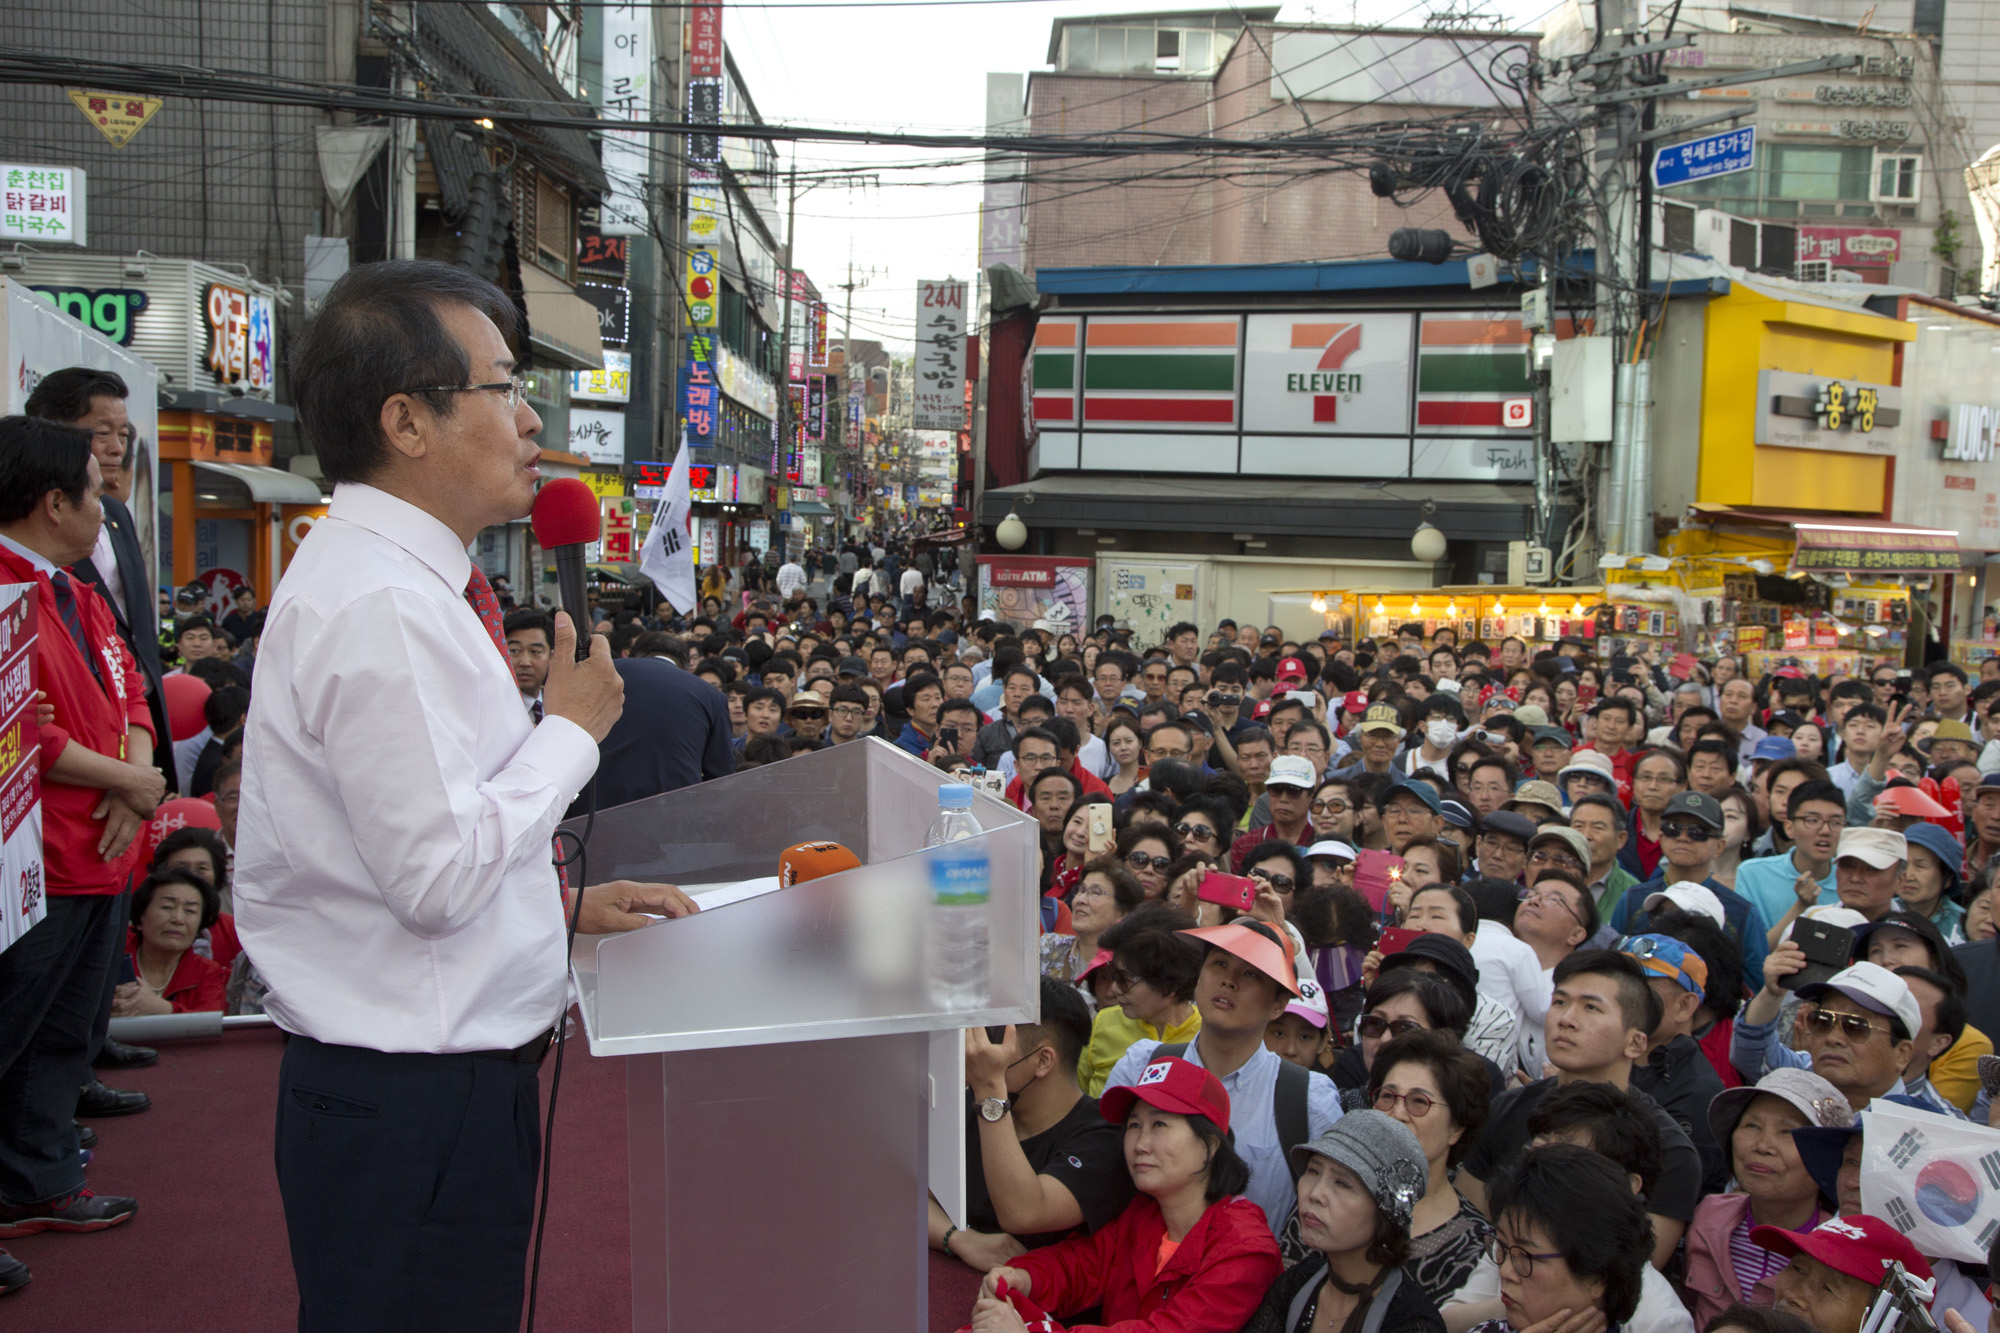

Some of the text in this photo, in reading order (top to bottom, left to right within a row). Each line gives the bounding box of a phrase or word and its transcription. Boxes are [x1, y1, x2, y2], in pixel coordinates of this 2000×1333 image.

[89, 98, 144, 118] 주의
[1680, 131, 1750, 164] 연세로5가길
[1687, 161, 1721, 175] Yonsei-ro
[6, 169, 65, 191] 춘천집
[6, 192, 66, 213] 닭갈비
[5, 214, 66, 235] 막국수
[924, 283, 962, 310] 24시
[692, 305, 711, 320] 5F
[688, 362, 712, 435] 노래방
[1953, 404, 2000, 462] JUICY
[1487, 447, 1527, 469] Fresh
[608, 508, 631, 563] 노래
[997, 571, 1047, 582] LOTTE ATM
[20, 870, 30, 917] 2
